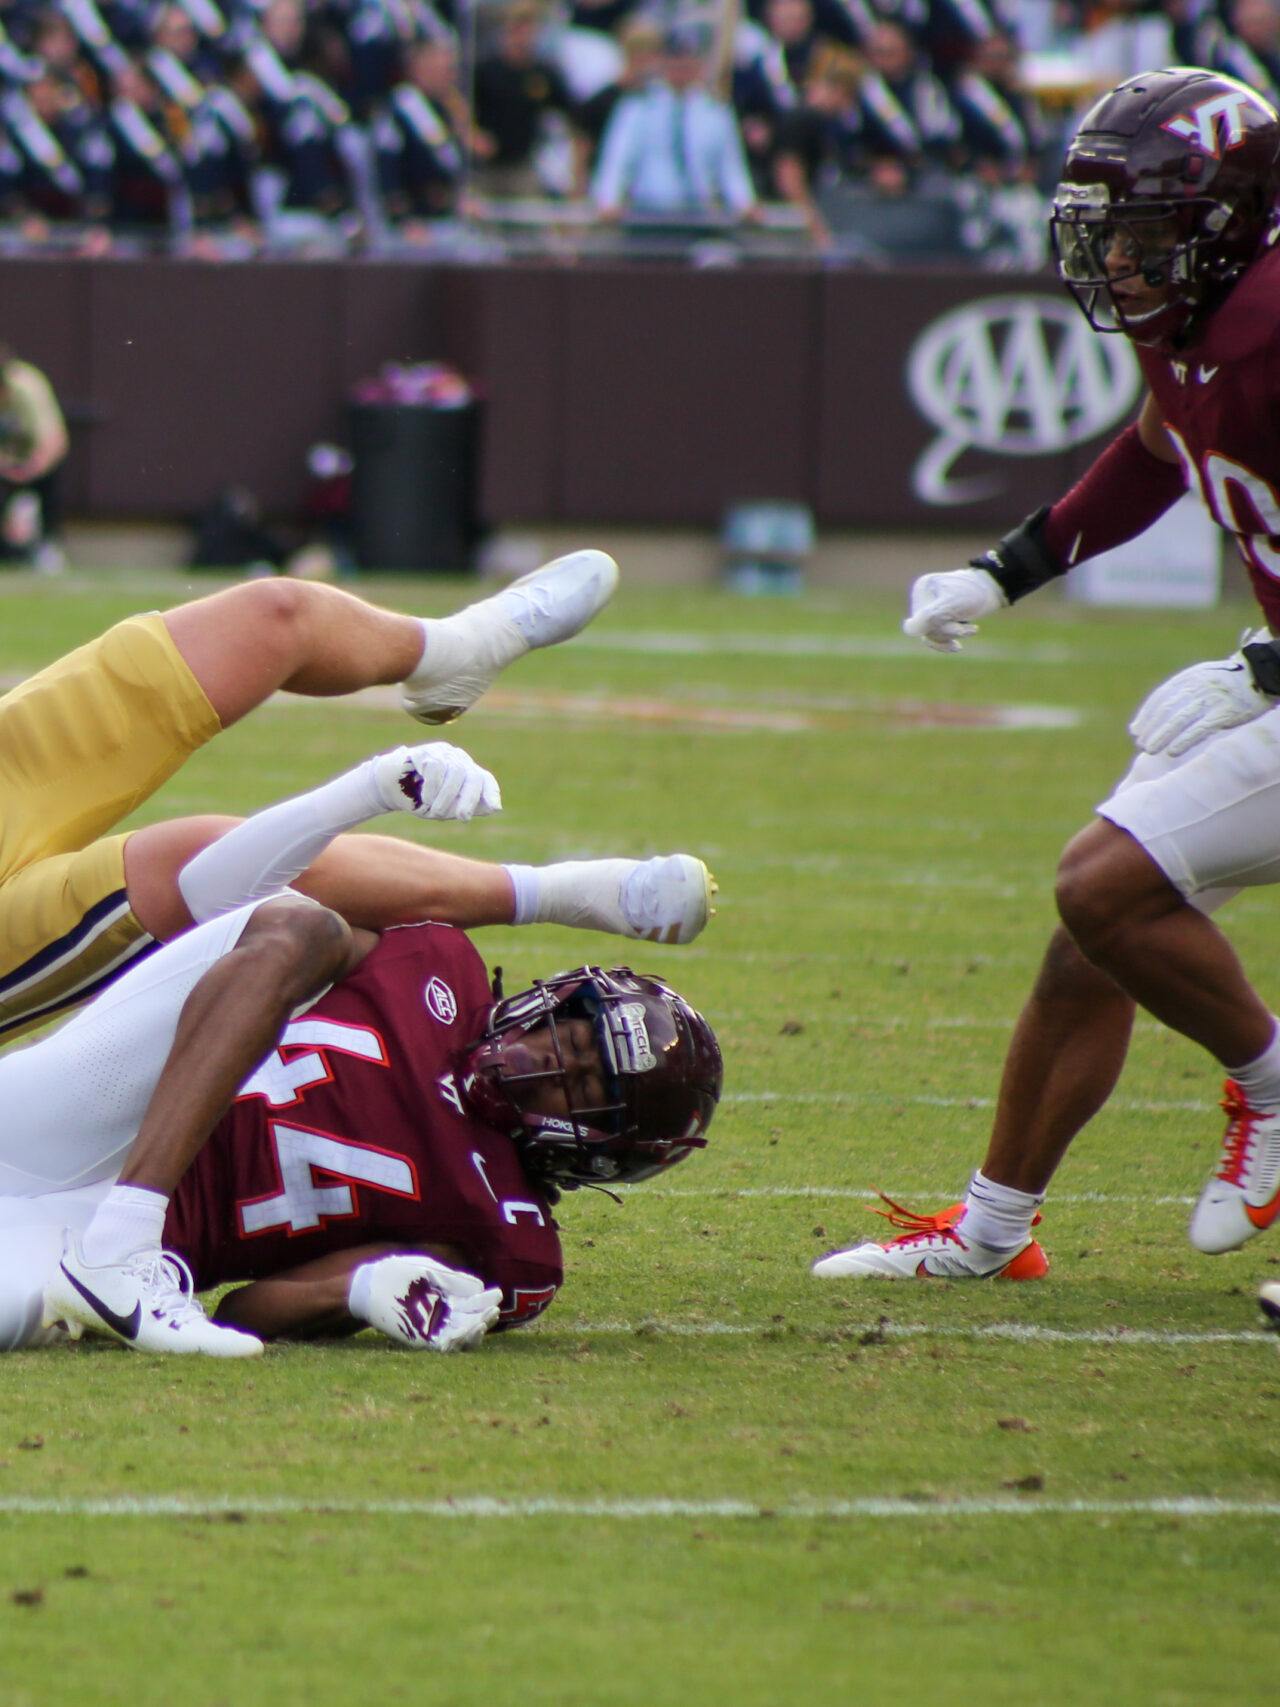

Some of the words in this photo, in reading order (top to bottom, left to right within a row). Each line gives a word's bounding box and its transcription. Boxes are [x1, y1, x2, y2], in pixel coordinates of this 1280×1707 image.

[929, 300, 1128, 448] AAA
[633, 1021, 648, 1056] TECH
[230, 1015, 421, 1240] 44
